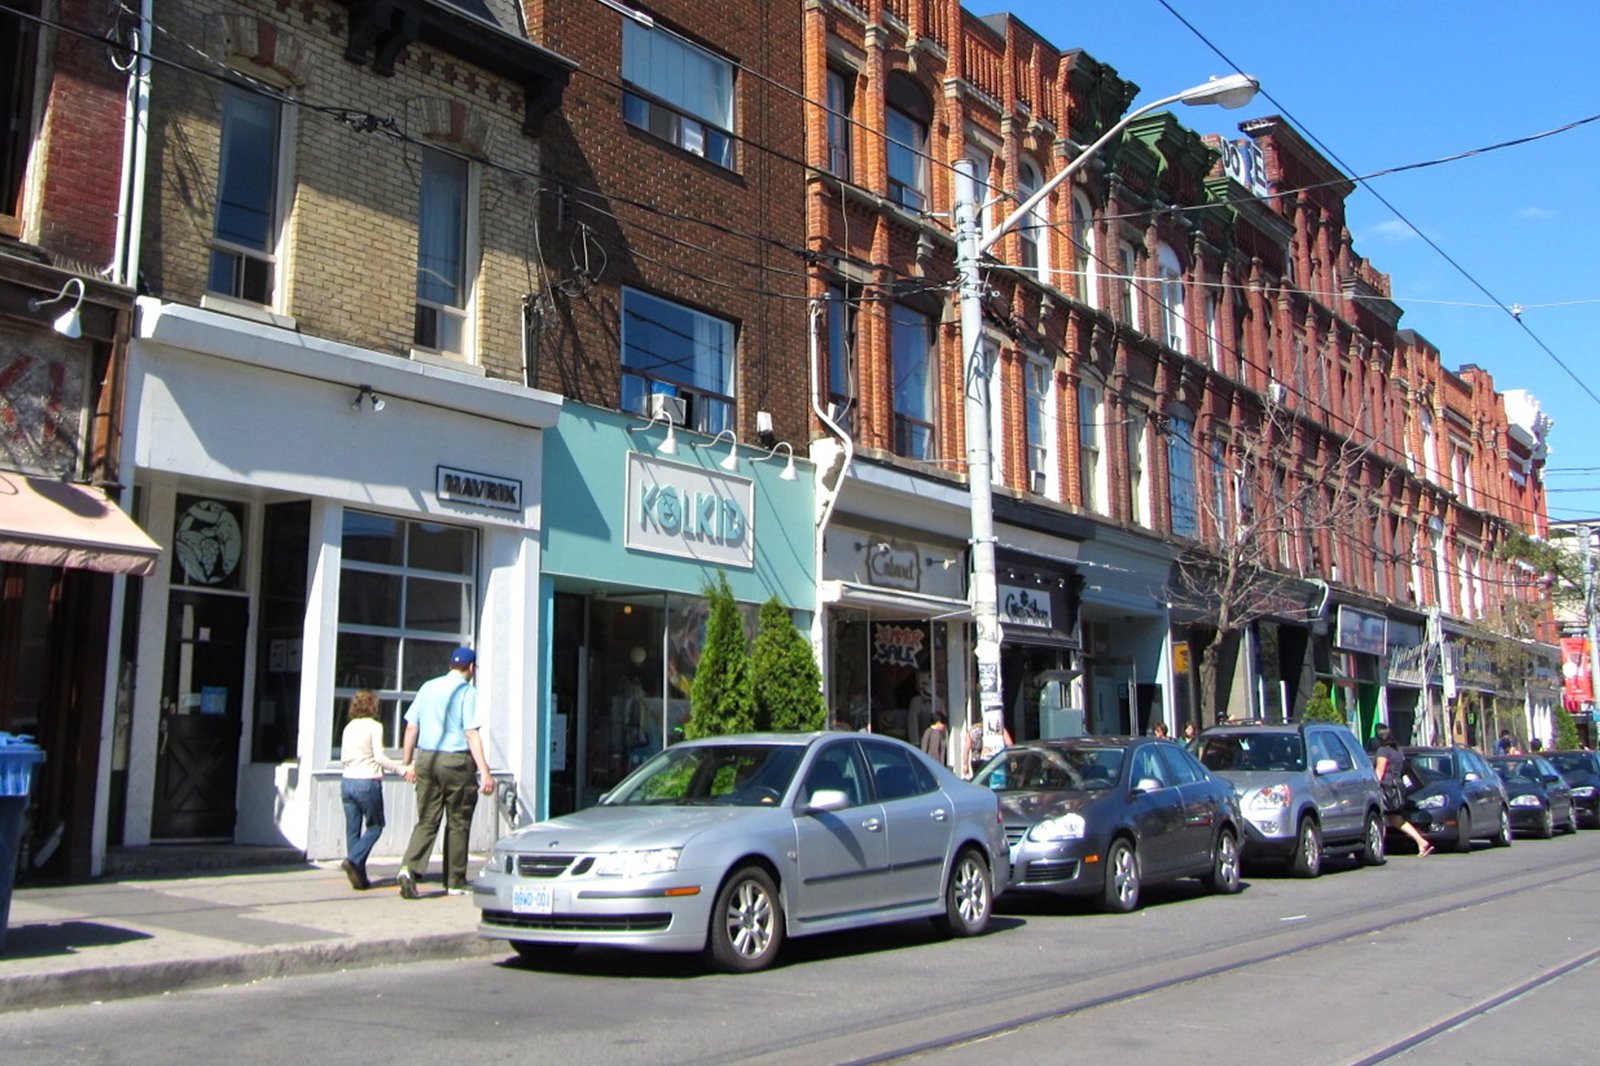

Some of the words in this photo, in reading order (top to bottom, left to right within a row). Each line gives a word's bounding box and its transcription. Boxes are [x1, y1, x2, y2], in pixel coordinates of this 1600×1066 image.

[444, 473, 517, 504] MAVRIK
[638, 479, 747, 547] KOLKID
[877, 642, 914, 663] SALE
